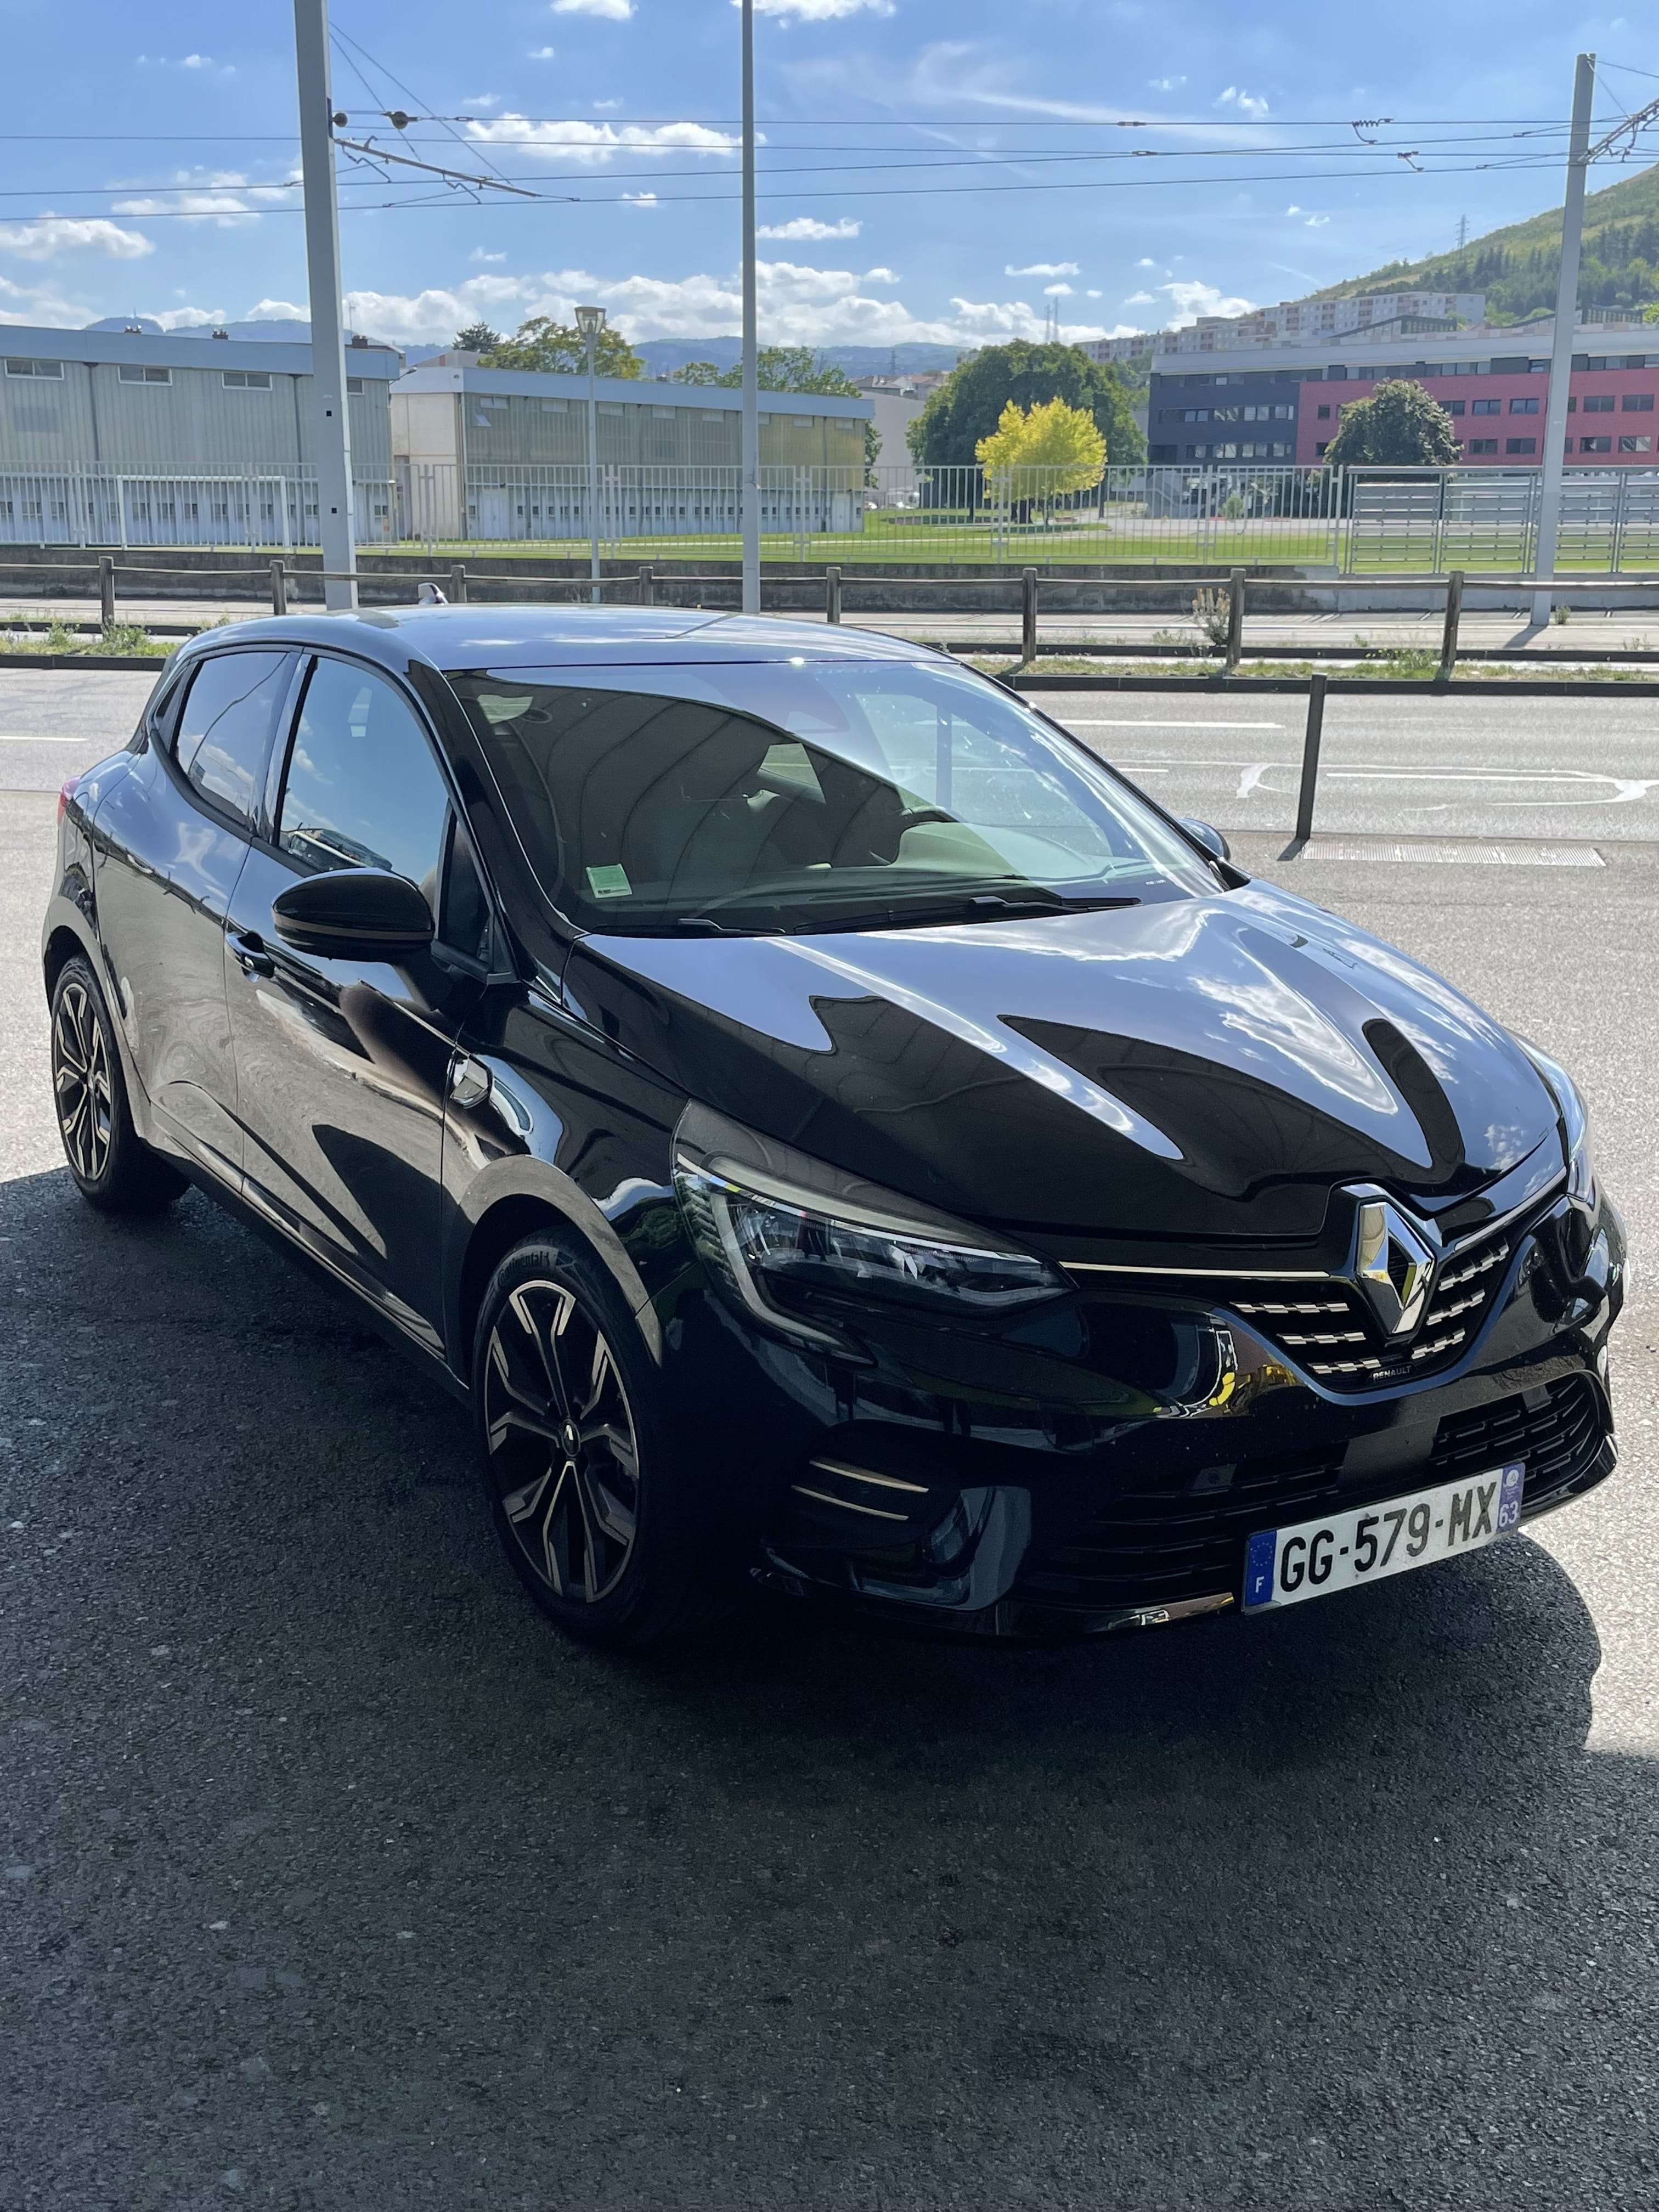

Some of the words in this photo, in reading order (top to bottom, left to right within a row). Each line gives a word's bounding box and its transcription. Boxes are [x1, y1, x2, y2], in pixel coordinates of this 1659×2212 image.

[1373, 1365, 1412, 1380] RENAULT
[1499, 1500, 1519, 1527] 63
[1280, 1481, 1497, 1593] GG-579-MX
[1255, 1576, 1265, 1593] F
